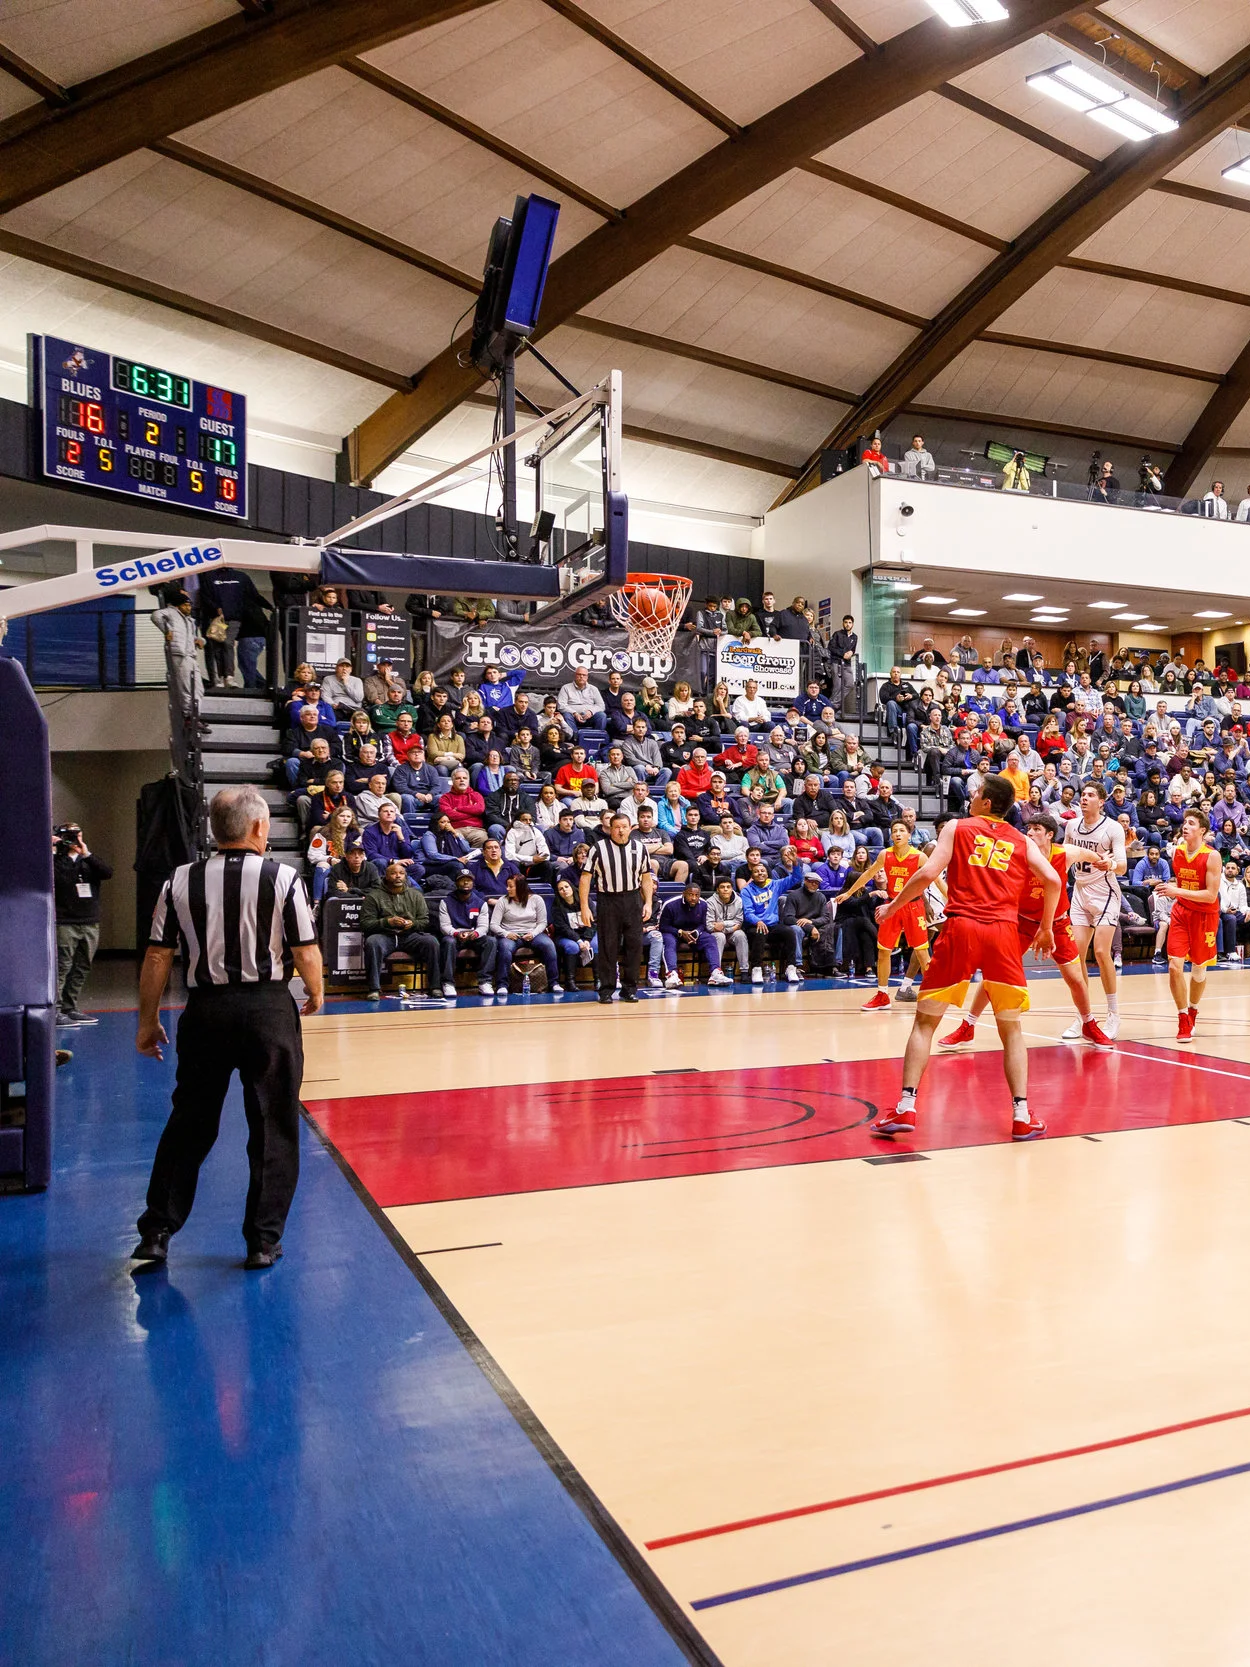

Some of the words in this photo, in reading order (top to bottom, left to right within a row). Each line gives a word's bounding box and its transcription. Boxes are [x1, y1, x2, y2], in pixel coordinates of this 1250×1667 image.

[61, 378, 102, 401] BLUES
[132, 365, 189, 405] 6:31
[78, 402, 104, 433] 16
[138, 406, 168, 423] PERIOD
[56, 426, 85, 442] FOULS
[145, 422, 158, 445] 2
[200, 417, 235, 438] GUEST
[66, 441, 81, 464] 2
[94, 436, 117, 450] T.O.L.
[213, 439, 236, 466] 17
[99, 450, 112, 471] 5
[125, 444, 156, 460] PLAYER
[159, 452, 179, 466] FOUL
[56, 465, 85, 480] SCORE
[190, 471, 203, 493] 5
[214, 466, 239, 480] FOULS
[138, 484, 167, 498] MATCH
[222, 478, 235, 500] 0
[214, 501, 239, 514] SCORE
[96, 547, 222, 587] Schelde
[365, 613, 390, 621] Follow
[753, 664, 794, 674] Showcase
[968, 834, 1015, 872] 32
[893, 877, 904, 893] 5
